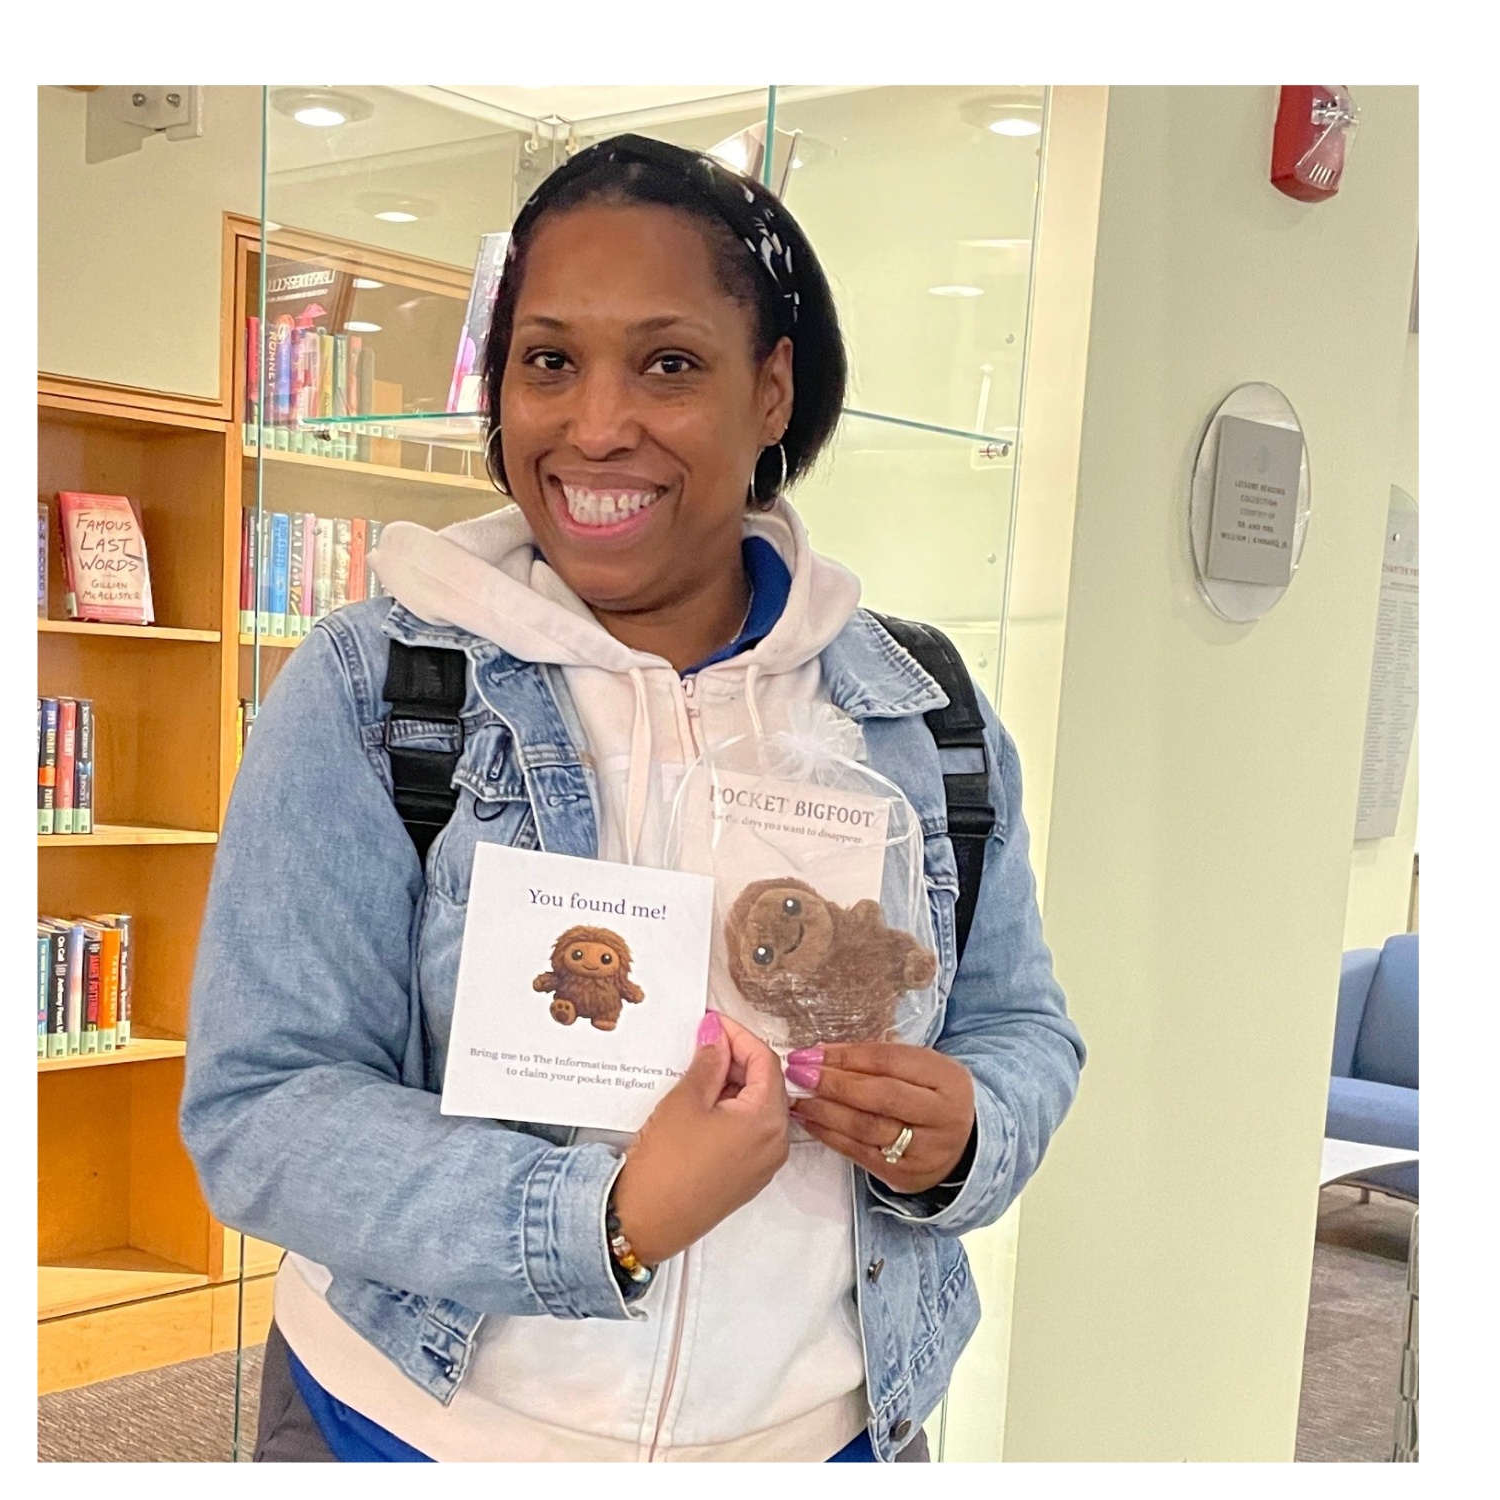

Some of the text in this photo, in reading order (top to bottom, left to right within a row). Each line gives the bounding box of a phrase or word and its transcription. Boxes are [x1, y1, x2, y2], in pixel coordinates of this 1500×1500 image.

[76, 512, 132, 534] FAMOUS
[80, 531, 134, 555] LAST
[79, 554, 138, 572] WORDS
[91, 579, 128, 589] GILLIAN
[794, 800, 874, 828] BIGFOOT
[741, 816, 762, 829] days
[764, 823, 781, 832] you
[783, 824, 805, 835] want
[807, 827, 816, 836] to
[818, 828, 864, 845] disappear.
[529, 888, 667, 920] You found me!
[470, 1047, 498, 1060] Bring
[501, 1053, 517, 1061] me
[519, 1053, 530, 1062] to
[533, 1054, 552, 1064] The
[555, 1056, 617, 1071] Information
[620, 1063, 663, 1076] Services
[506, 1066, 655, 1090] to claim your pocket Bigfoot!
